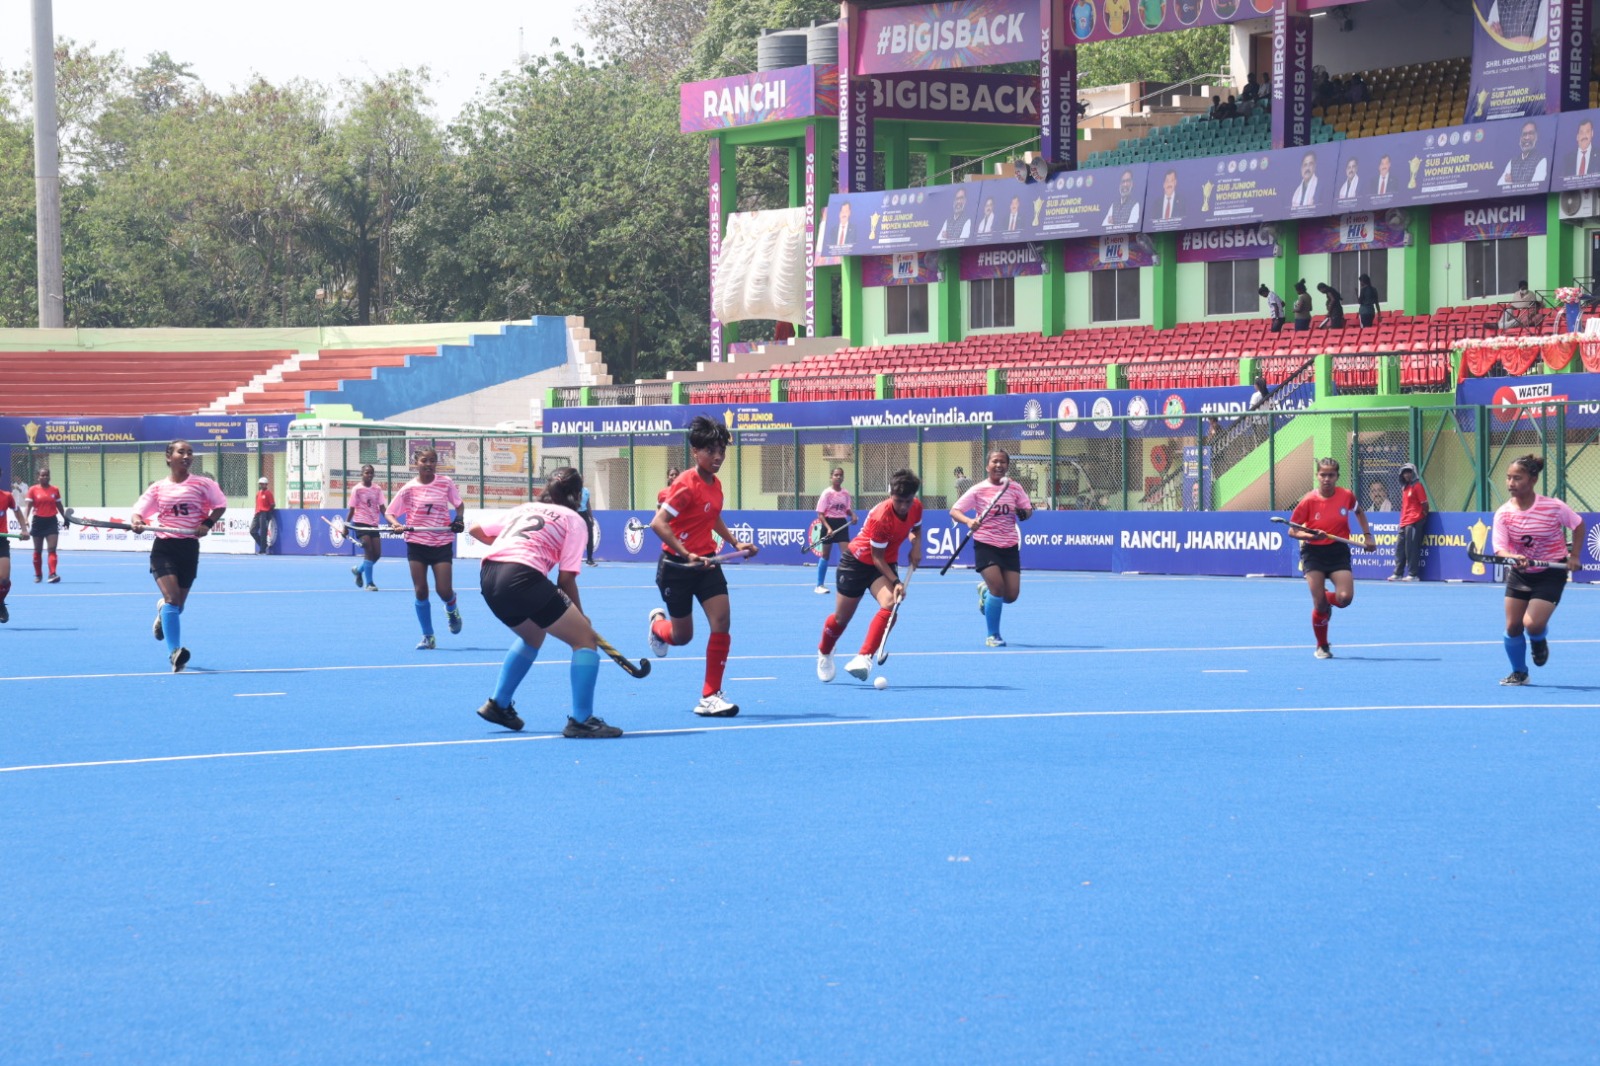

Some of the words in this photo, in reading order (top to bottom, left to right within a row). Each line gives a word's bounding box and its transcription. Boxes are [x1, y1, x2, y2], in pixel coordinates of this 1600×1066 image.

[876, 12, 1026, 55] #BIGISBACK
[1548, 0, 1562, 75] #BIGIS
[1274, 1, 1285, 100] #HEROHIL
[1041, 27, 1051, 137] #BIGISBACK
[1293, 29, 1307, 147] #BIGISBACK
[703, 79, 787, 119] RANCHI
[1491, 91, 1505, 99] SUB
[1505, 87, 1529, 98] JUNIOR
[1490, 97, 1516, 107] WOMEN
[838, 67, 849, 153] #HEROHIL
[1059, 69, 1072, 162] #HEROHIL
[855, 89, 867, 193] #BIGISBACK
[1425, 157, 1441, 167] SUB
[1441, 154, 1471, 166] JUNIOR
[1424, 165, 1454, 177] WOMEN
[1454, 160, 1495, 174] NATIONAL
[805, 152, 815, 225] 2025-26
[1215, 191, 1242, 201] WOMEN
[1242, 187, 1277, 199] NATIONAL
[1216, 183, 1231, 193] SUB
[1231, 180, 1256, 191] JUNIOR
[1045, 207, 1069, 216] WOMEN
[1069, 204, 1100, 214] NATIONAL
[1046, 200, 1059, 208] SUB
[1059, 197, 1082, 207] JUNIOR
[710, 181, 720, 253] 2025-26
[1463, 204, 1526, 227] RANCHI
[805, 232, 815, 302] LEAGUE
[1518, 385, 1550, 398] WATCH
[737, 413, 750, 422] SUB
[750, 412, 774, 422] JUNIOR
[850, 406, 994, 432] www.hockeyindia.org
[45, 425, 66, 433] SUB
[67, 425, 103, 433] JUNIOR
[551, 420, 598, 440] RANCHI,
[600, 419, 673, 437] JHARKHAND
[45, 433, 84, 442] WOMEN
[85, 433, 135, 441] NATIONAL
[172, 503, 190, 517] 15
[424, 503, 434, 516] 7
[993, 503, 1010, 517] 20
[500, 514, 546, 540] 12
[1373, 523, 1400, 532] HOCKEY
[926, 527, 960, 555] SAI
[1024, 534, 1050, 546] GOVT.
[1051, 534, 1063, 546] OF
[1120, 530, 1181, 552] RANCHI,
[1183, 530, 1283, 551] JHARKHAND
[1422, 534, 1467, 546] ATIONAL
[1520, 534, 1534, 548] 2
[1352, 558, 1382, 568] RANCHI,
